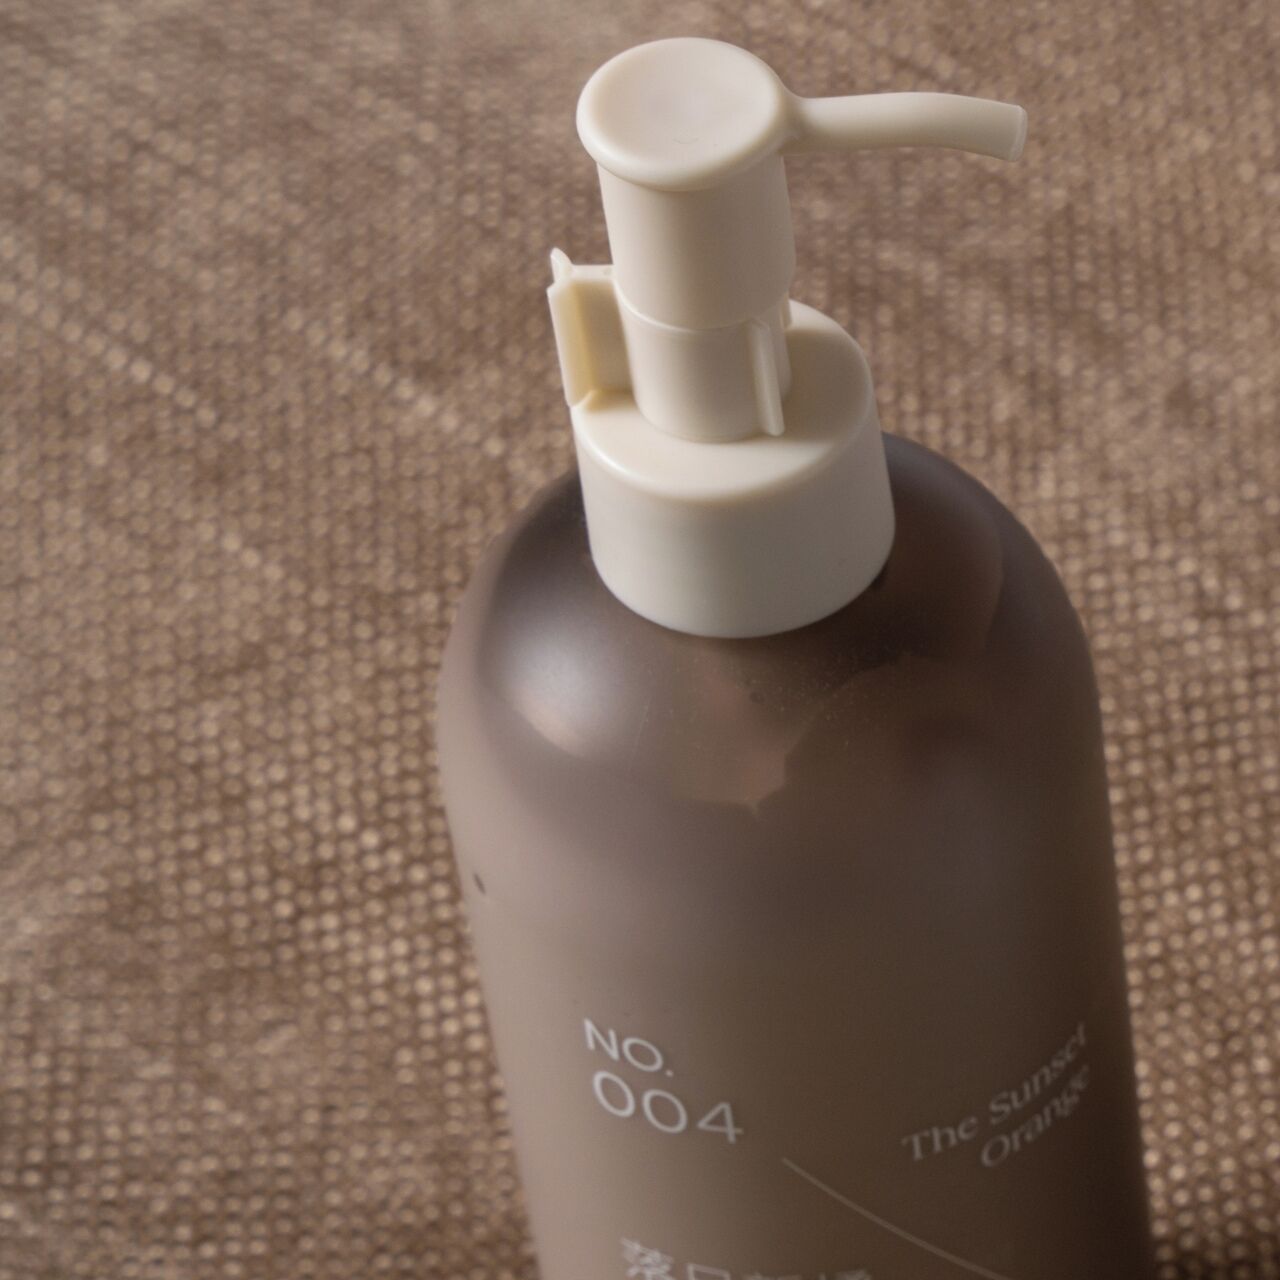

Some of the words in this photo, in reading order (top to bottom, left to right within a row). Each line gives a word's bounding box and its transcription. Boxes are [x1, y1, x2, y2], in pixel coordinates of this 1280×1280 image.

[583, 1017, 674, 1078] NO.
[592, 1070, 744, 1145] 004
[902, 1110, 980, 1163] The
[986, 1022, 1089, 1126] Sunset
[980, 1065, 1090, 1168] Orange
